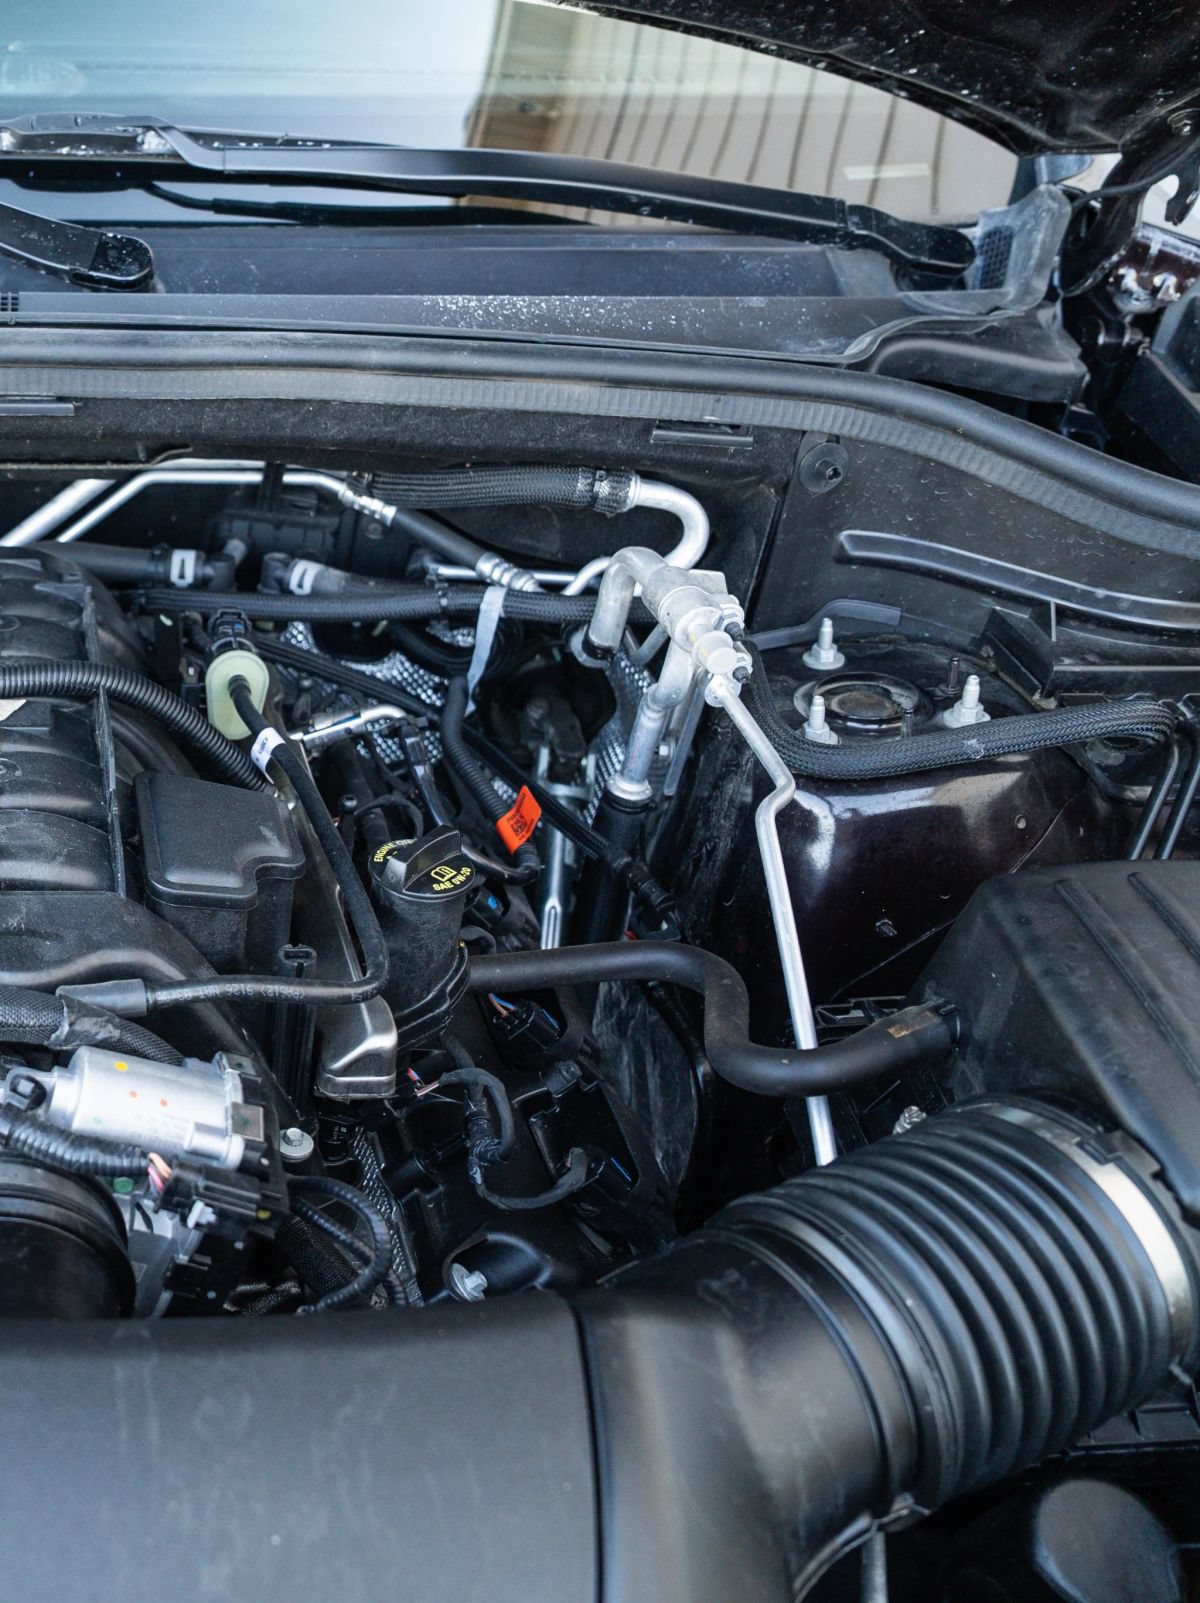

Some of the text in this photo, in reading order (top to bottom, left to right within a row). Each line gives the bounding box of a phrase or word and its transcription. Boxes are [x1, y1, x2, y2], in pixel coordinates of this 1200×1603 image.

[374, 843, 397, 862] ENGINE
[432, 867, 472, 891] SAE 0W-20
